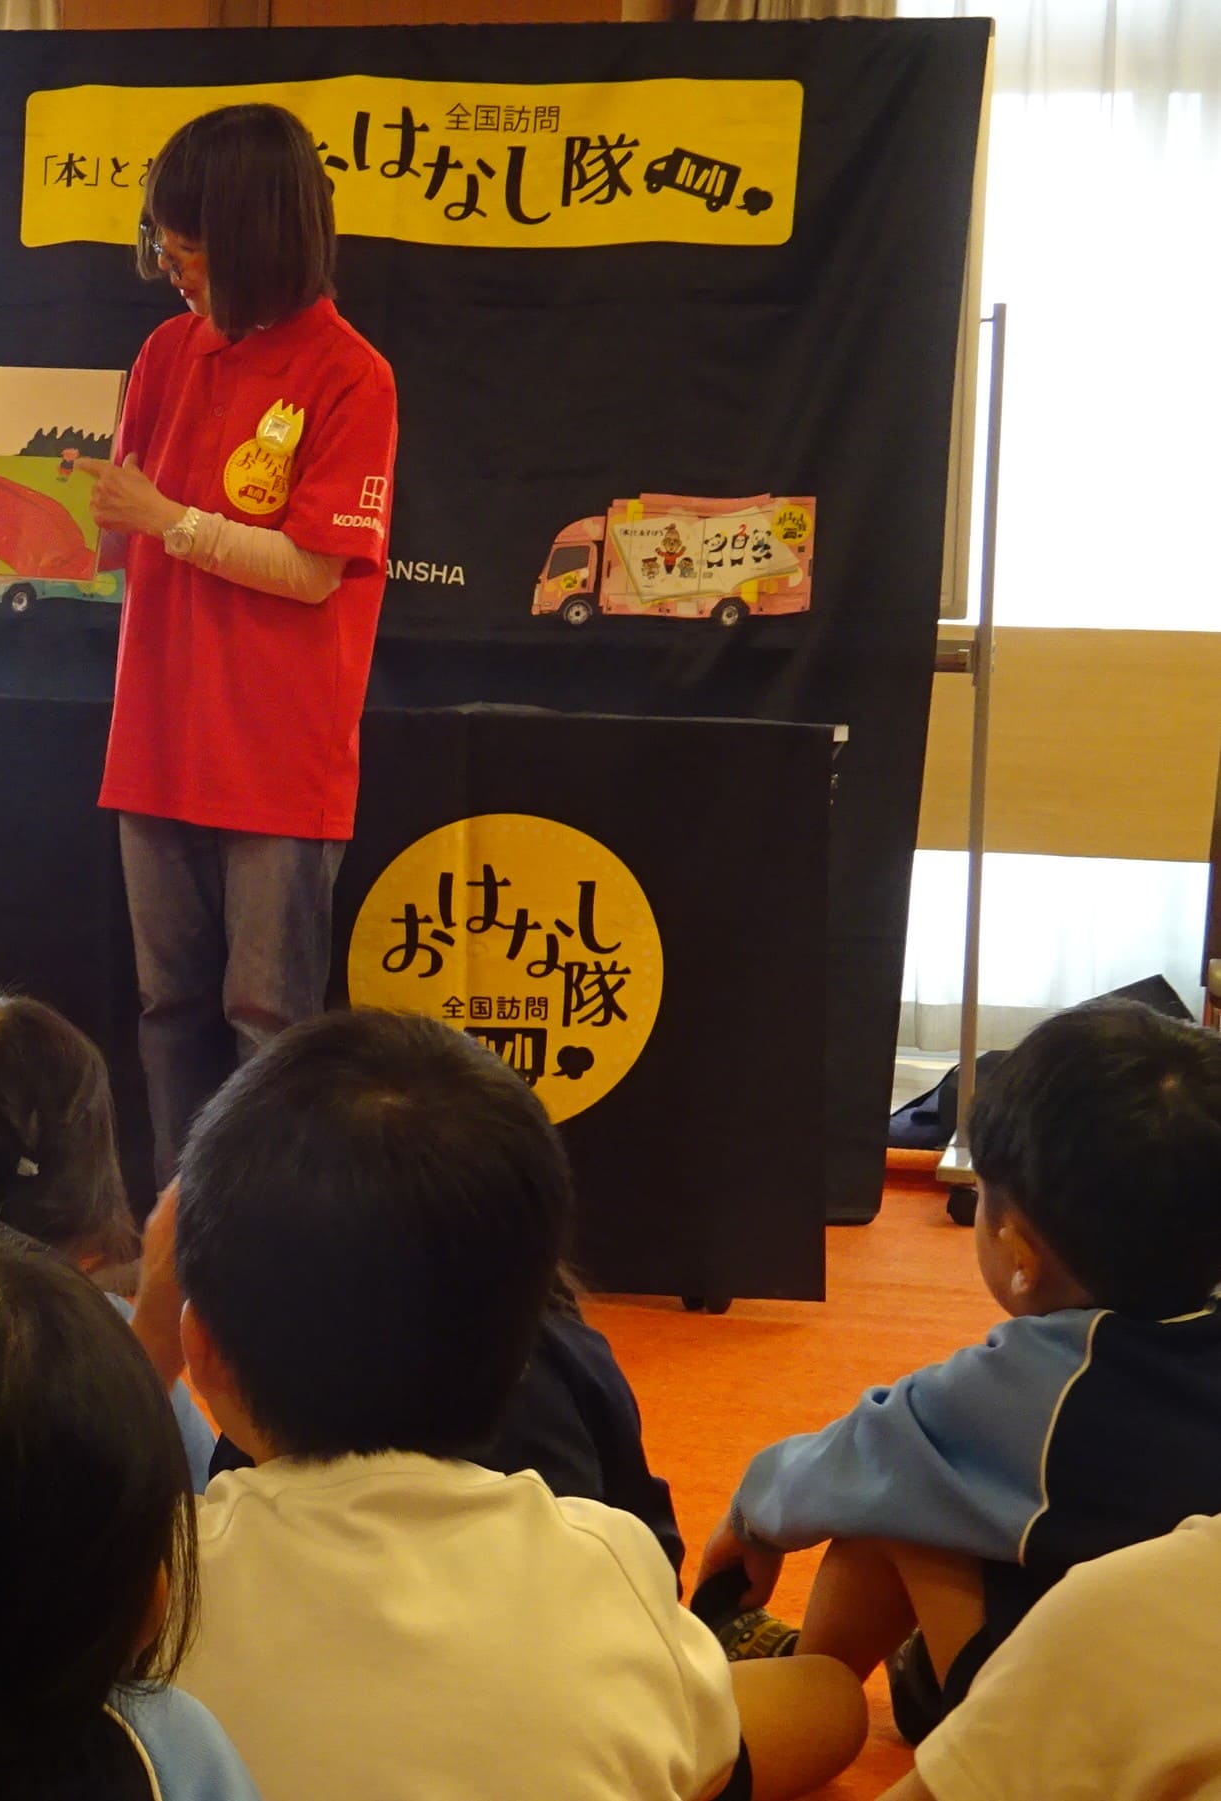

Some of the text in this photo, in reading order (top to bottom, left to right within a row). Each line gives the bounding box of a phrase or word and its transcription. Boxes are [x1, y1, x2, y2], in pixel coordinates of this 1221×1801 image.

[444, 103, 561, 133] 全国訪問
[316, 106, 640, 225] はなし隊
[381, 863, 632, 1028] おはなし隊
[441, 995, 549, 1021] 全国訪問
